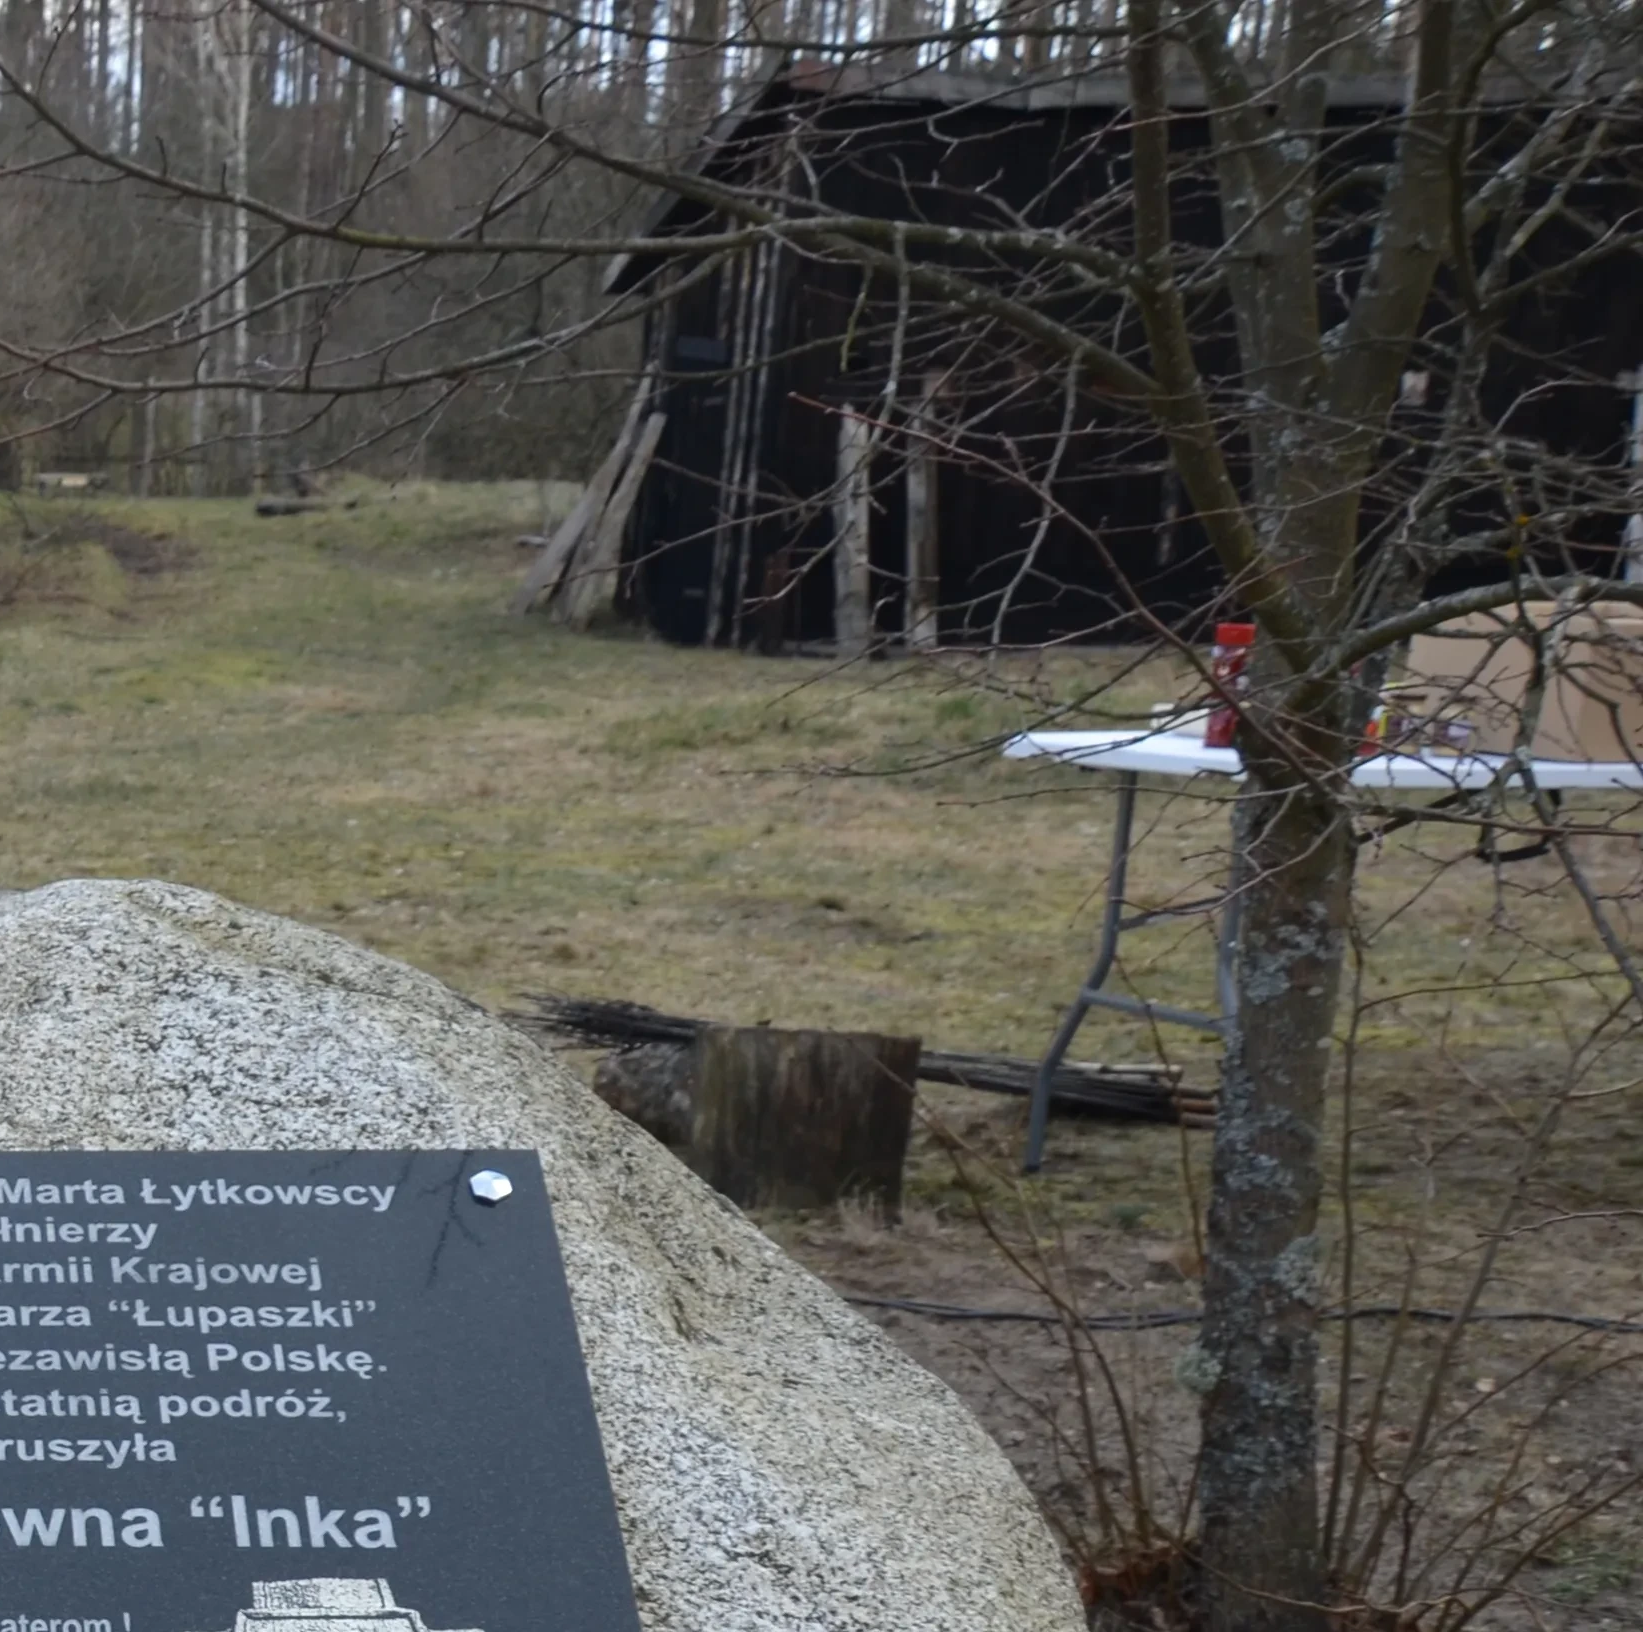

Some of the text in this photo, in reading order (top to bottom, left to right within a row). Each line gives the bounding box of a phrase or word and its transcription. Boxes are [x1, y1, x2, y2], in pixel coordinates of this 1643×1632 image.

[138, 1177, 397, 1213] Łytkowscy
[109, 1255, 323, 1292] Krajowej
[205, 1342, 388, 1381] Polskę.
[158, 1387, 347, 1425] podróż,
